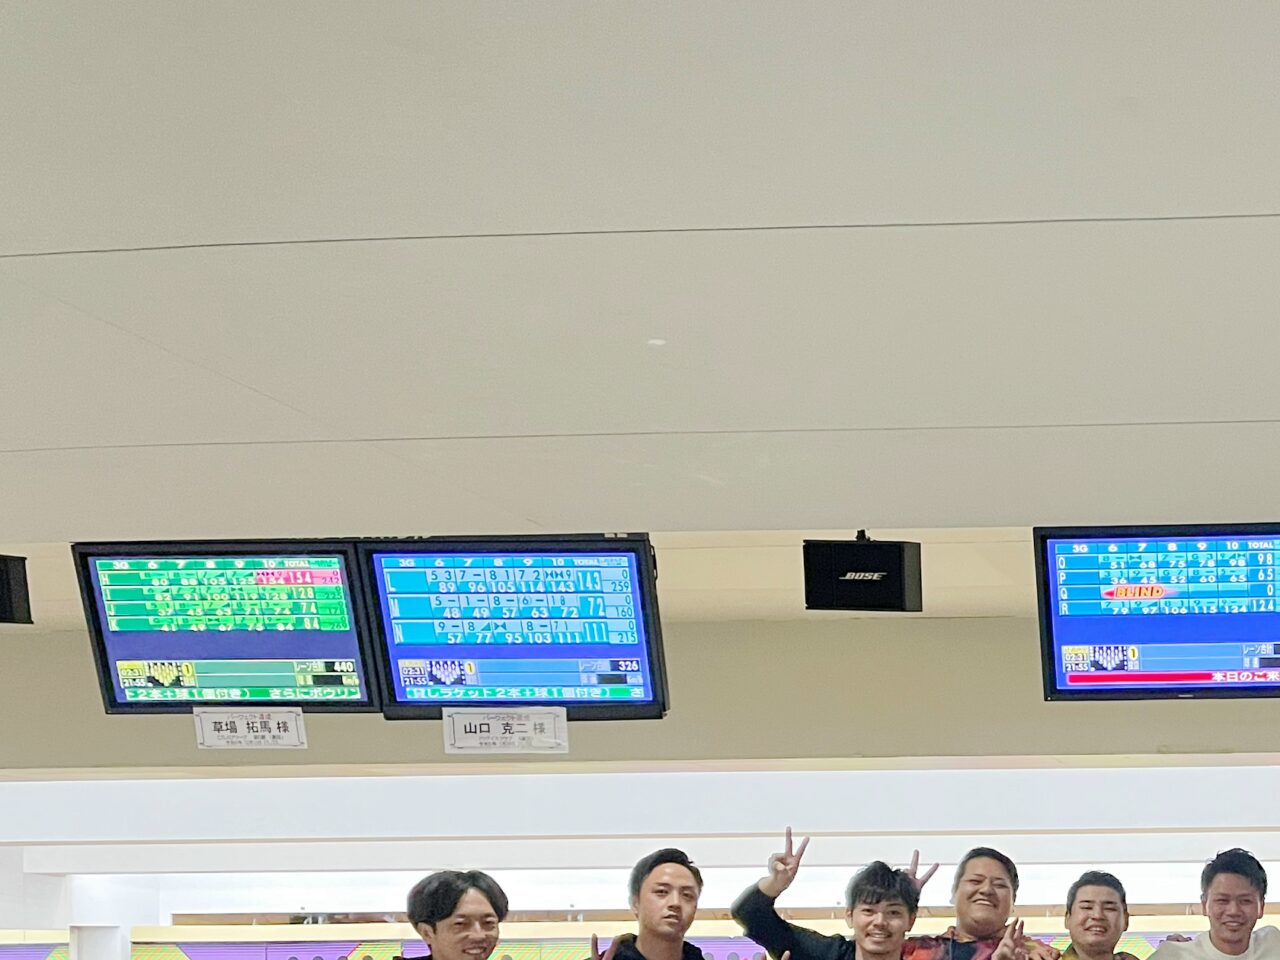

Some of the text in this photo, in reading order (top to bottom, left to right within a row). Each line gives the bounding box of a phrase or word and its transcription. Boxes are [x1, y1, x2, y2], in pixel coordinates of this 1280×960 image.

[1073, 544, 1088, 552] 3G
[1258, 554, 1273, 564] 98
[290, 572, 311, 583] 154
[839, 572, 886, 580] BOSE
[1258, 570, 1273, 580] 65
[438, 582, 455, 592] 89
[468, 582, 485, 592] 96
[491, 582, 514, 592] 105
[521, 582, 544, 592] 114
[551, 582, 574, 592] 143
[577, 572, 602, 590] 143
[612, 582, 629, 591] 259
[292, 588, 314, 599] 128
[1116, 586, 1164, 598] BLIND
[302, 602, 317, 614] 74
[443, 598, 632, 618] 48 49 57 63 72 72 160
[1252, 600, 1274, 611] 124
[304, 618, 320, 628] 84
[448, 623, 636, 644] 57 77 95 103 111 111 215
[334, 662, 352, 672] 440
[618, 662, 638, 670] 326
[212, 721, 237, 733] 草場
[247, 721, 271, 733] 拓馬
[464, 722, 490, 734] 山口
[502, 722, 528, 734] 克二
